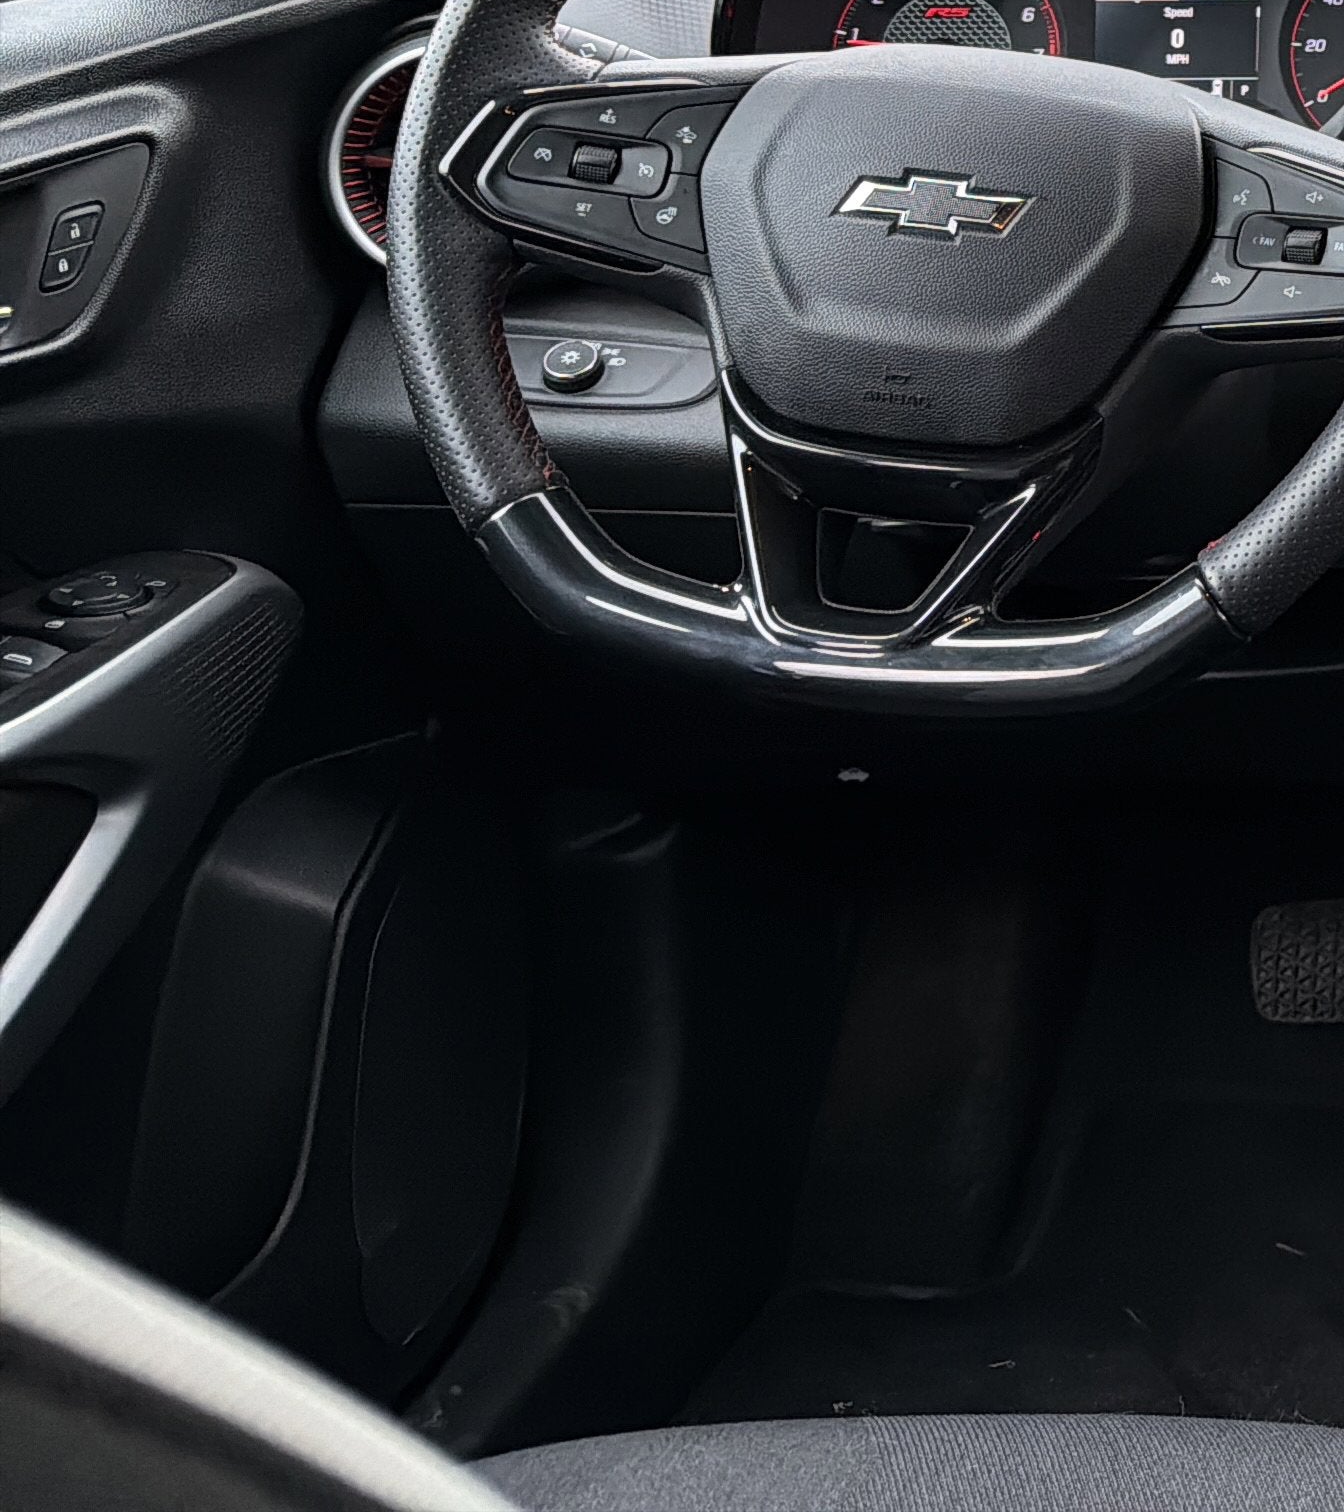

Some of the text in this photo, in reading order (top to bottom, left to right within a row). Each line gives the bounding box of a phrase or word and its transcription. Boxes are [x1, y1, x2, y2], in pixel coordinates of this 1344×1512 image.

[924, 6, 972, 19] RS
[1021, 7, 1036, 23] 6
[1163, 6, 1195, 20] Speed
[851, 27, 860, 41] 1
[1170, 28, 1186, 49] 0
[1304, 38, 1327, 53] 20
[1165, 53, 1191, 65] MPH
[1240, 84, 1250, 96] P
[599, 113, 617, 125] RES
[575, 202, 593, 213] SET
[1259, 236, 1276, 248] FAV
